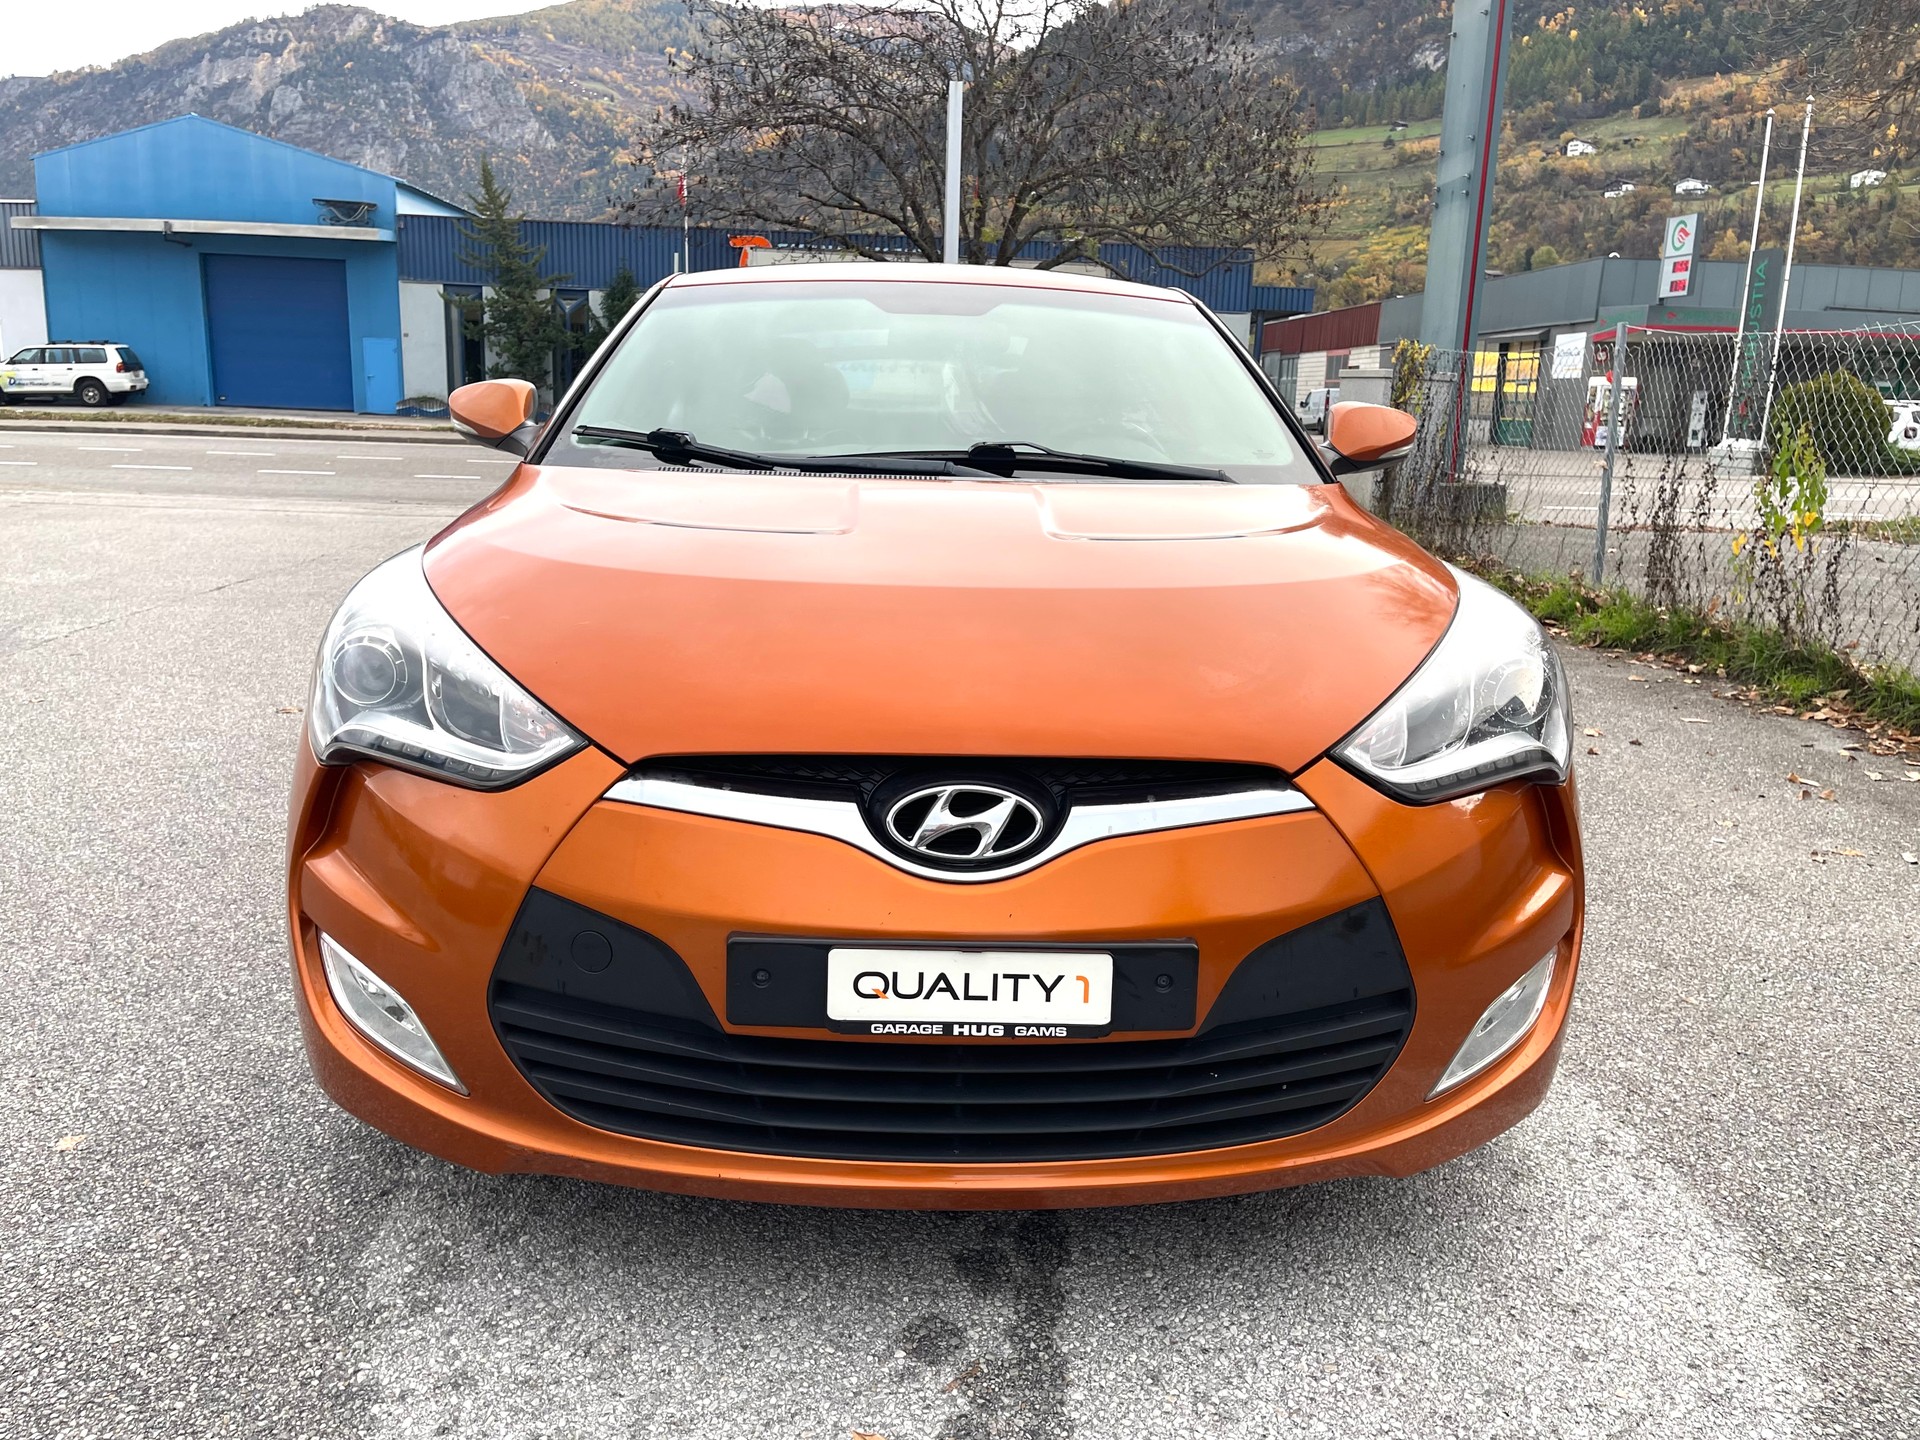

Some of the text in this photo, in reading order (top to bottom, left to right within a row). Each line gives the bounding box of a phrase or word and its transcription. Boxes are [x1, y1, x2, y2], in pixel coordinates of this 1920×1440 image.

[853, 971, 1090, 1004] QUALITY 1
[870, 1023, 1067, 1037] GARAGE HUG GAMS
